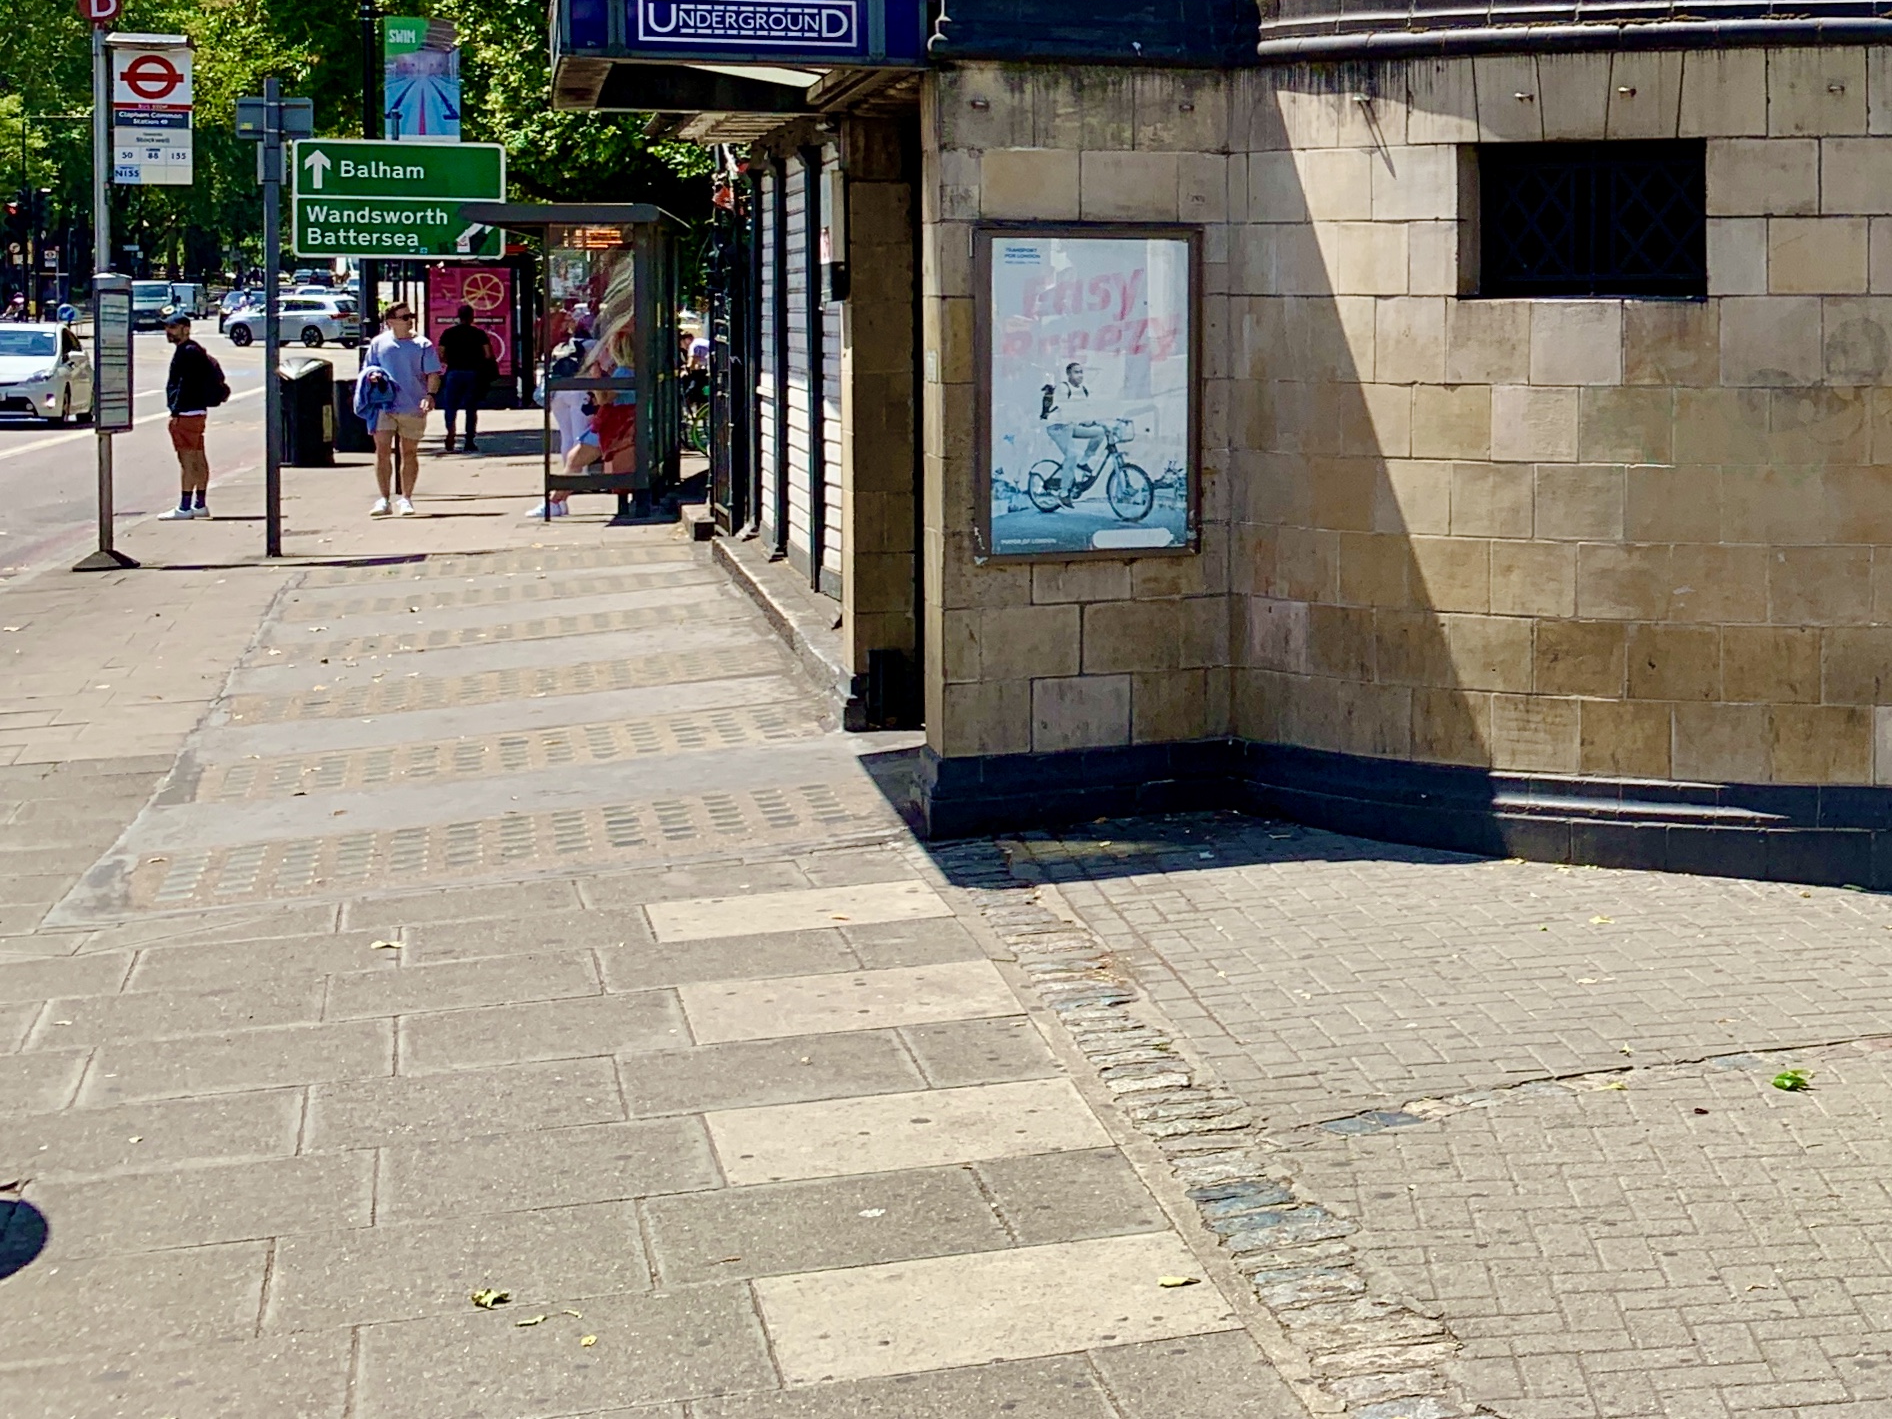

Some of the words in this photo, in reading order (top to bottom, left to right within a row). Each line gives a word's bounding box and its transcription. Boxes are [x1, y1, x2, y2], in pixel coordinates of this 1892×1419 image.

[647, 2, 849, 38] UNDERGROUND
[388, 29, 416, 44] SWIM
[118, 111, 150, 119] Clapham
[150, 111, 183, 119] Common
[115, 169, 140, 178] N155
[340, 160, 425, 179] Balham
[306, 205, 449, 225] Wandsworth
[307, 228, 419, 247] Battersea
